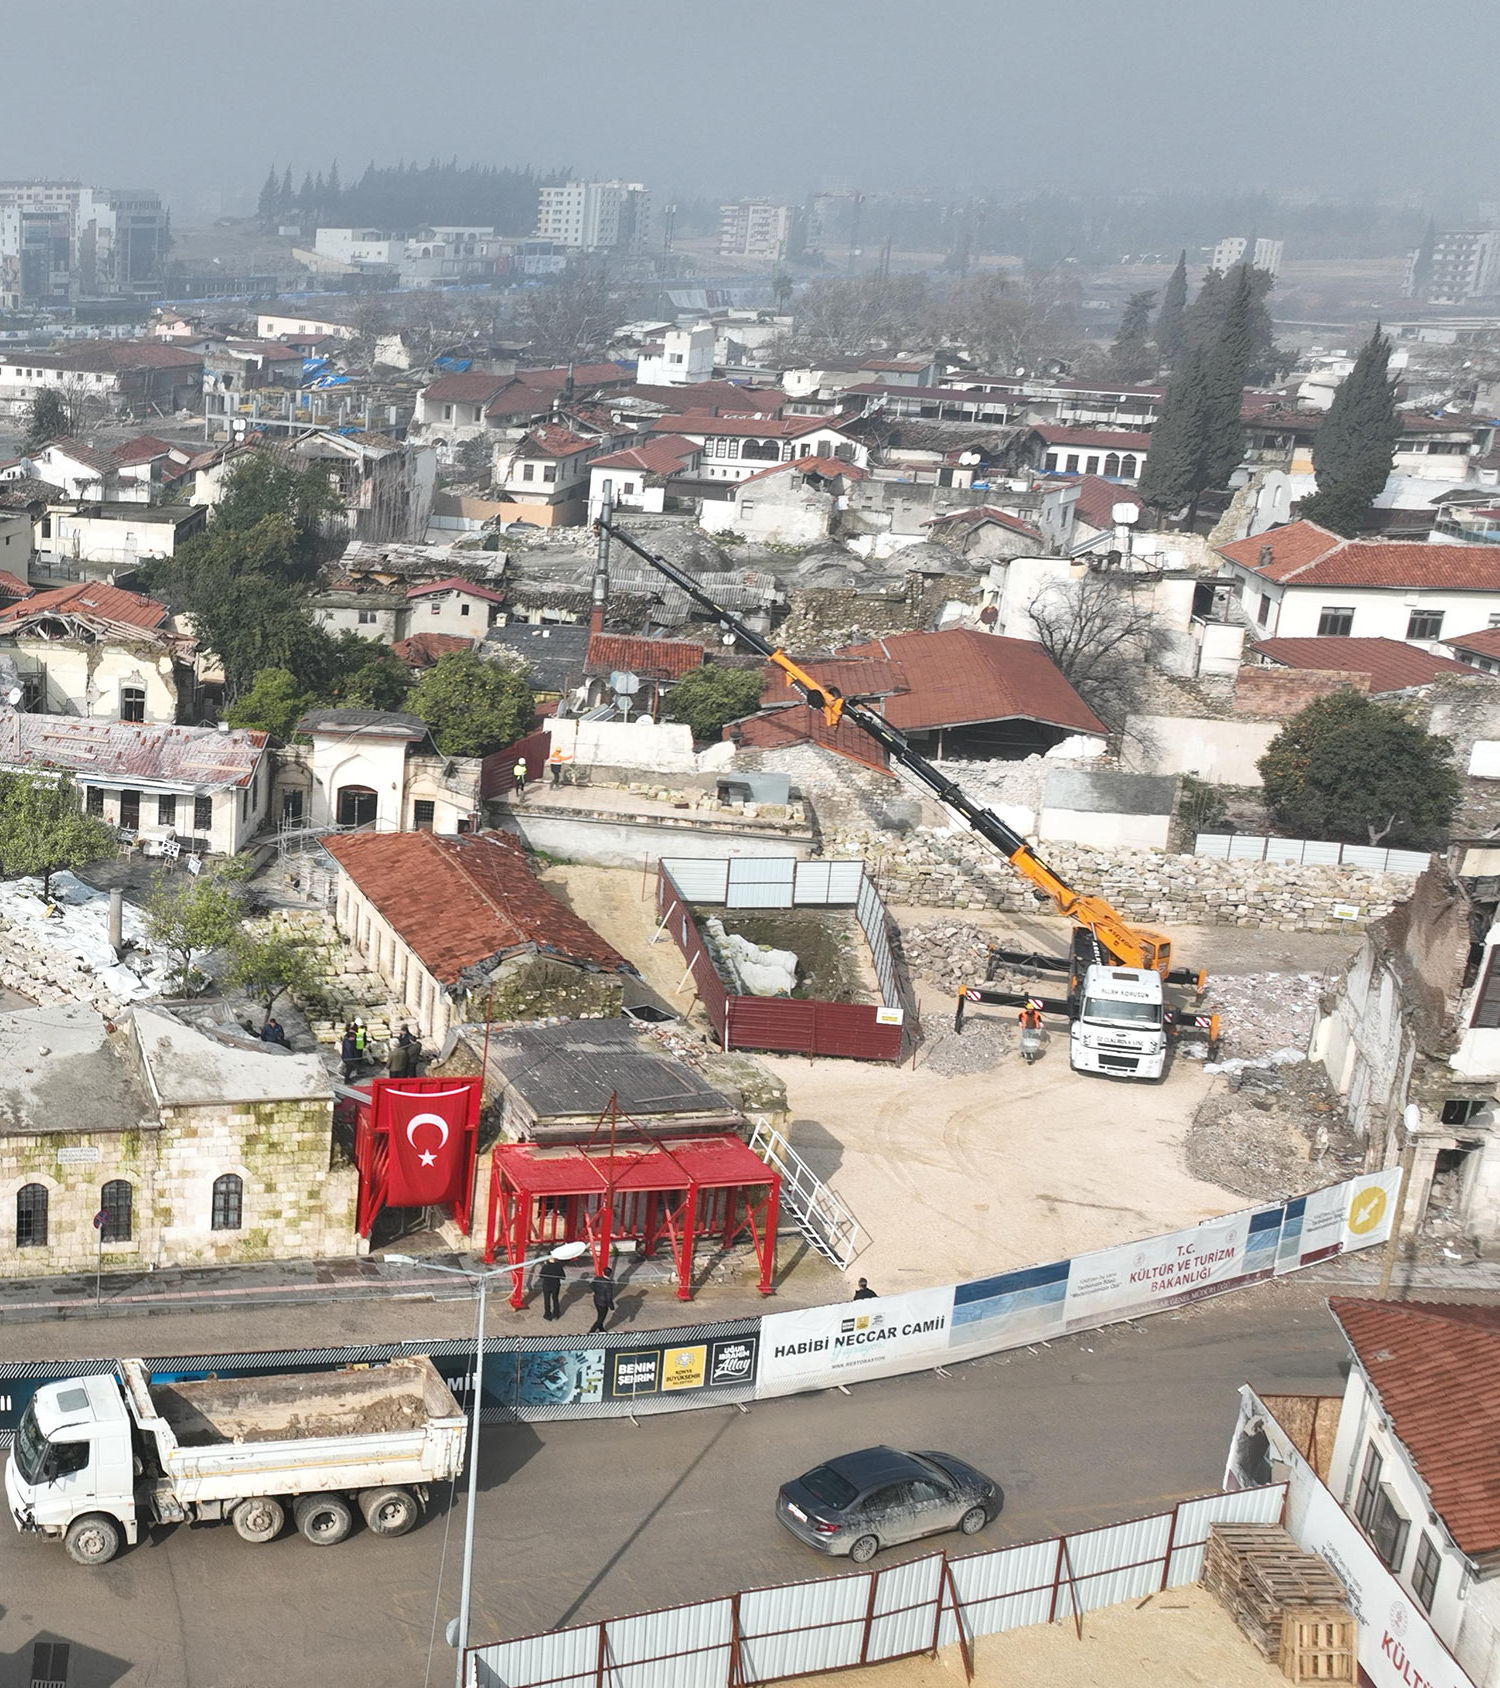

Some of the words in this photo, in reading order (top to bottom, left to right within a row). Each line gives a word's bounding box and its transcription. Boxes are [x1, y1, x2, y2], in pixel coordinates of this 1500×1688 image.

[1176, 1243, 1195, 1257] T.C.
[1129, 1263, 1174, 1284] KÜLTÜR
[1177, 1260, 1190, 1271] VE
[1194, 1247, 1236, 1267] TURİZM
[1150, 1267, 1211, 1293] BAKANLIĞI
[774, 1335, 830, 1358] HABİBİ
[834, 1326, 897, 1347] NECCAR
[618, 1361, 656, 1375] BENİM
